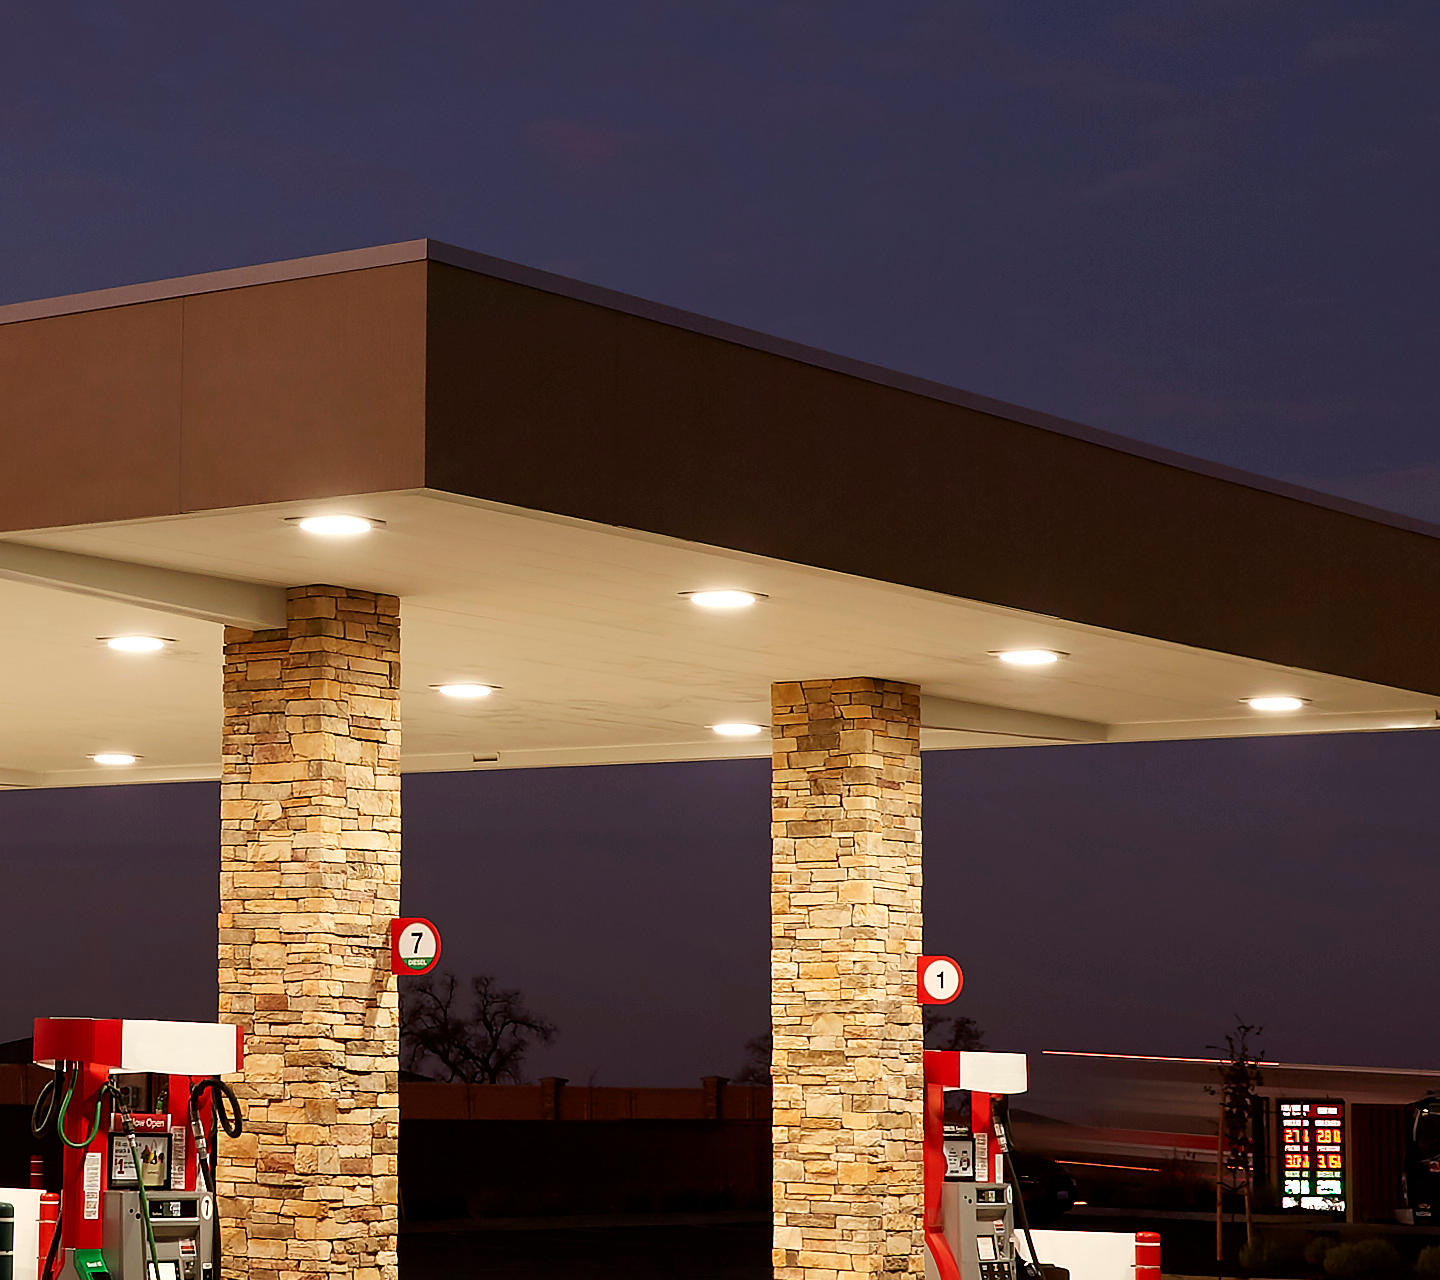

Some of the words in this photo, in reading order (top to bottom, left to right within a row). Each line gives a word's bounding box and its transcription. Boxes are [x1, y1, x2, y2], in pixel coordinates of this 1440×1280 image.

[411, 932, 423, 954] 7
[936, 971, 944, 989] 1
[146, 1118, 165, 1129] Open
